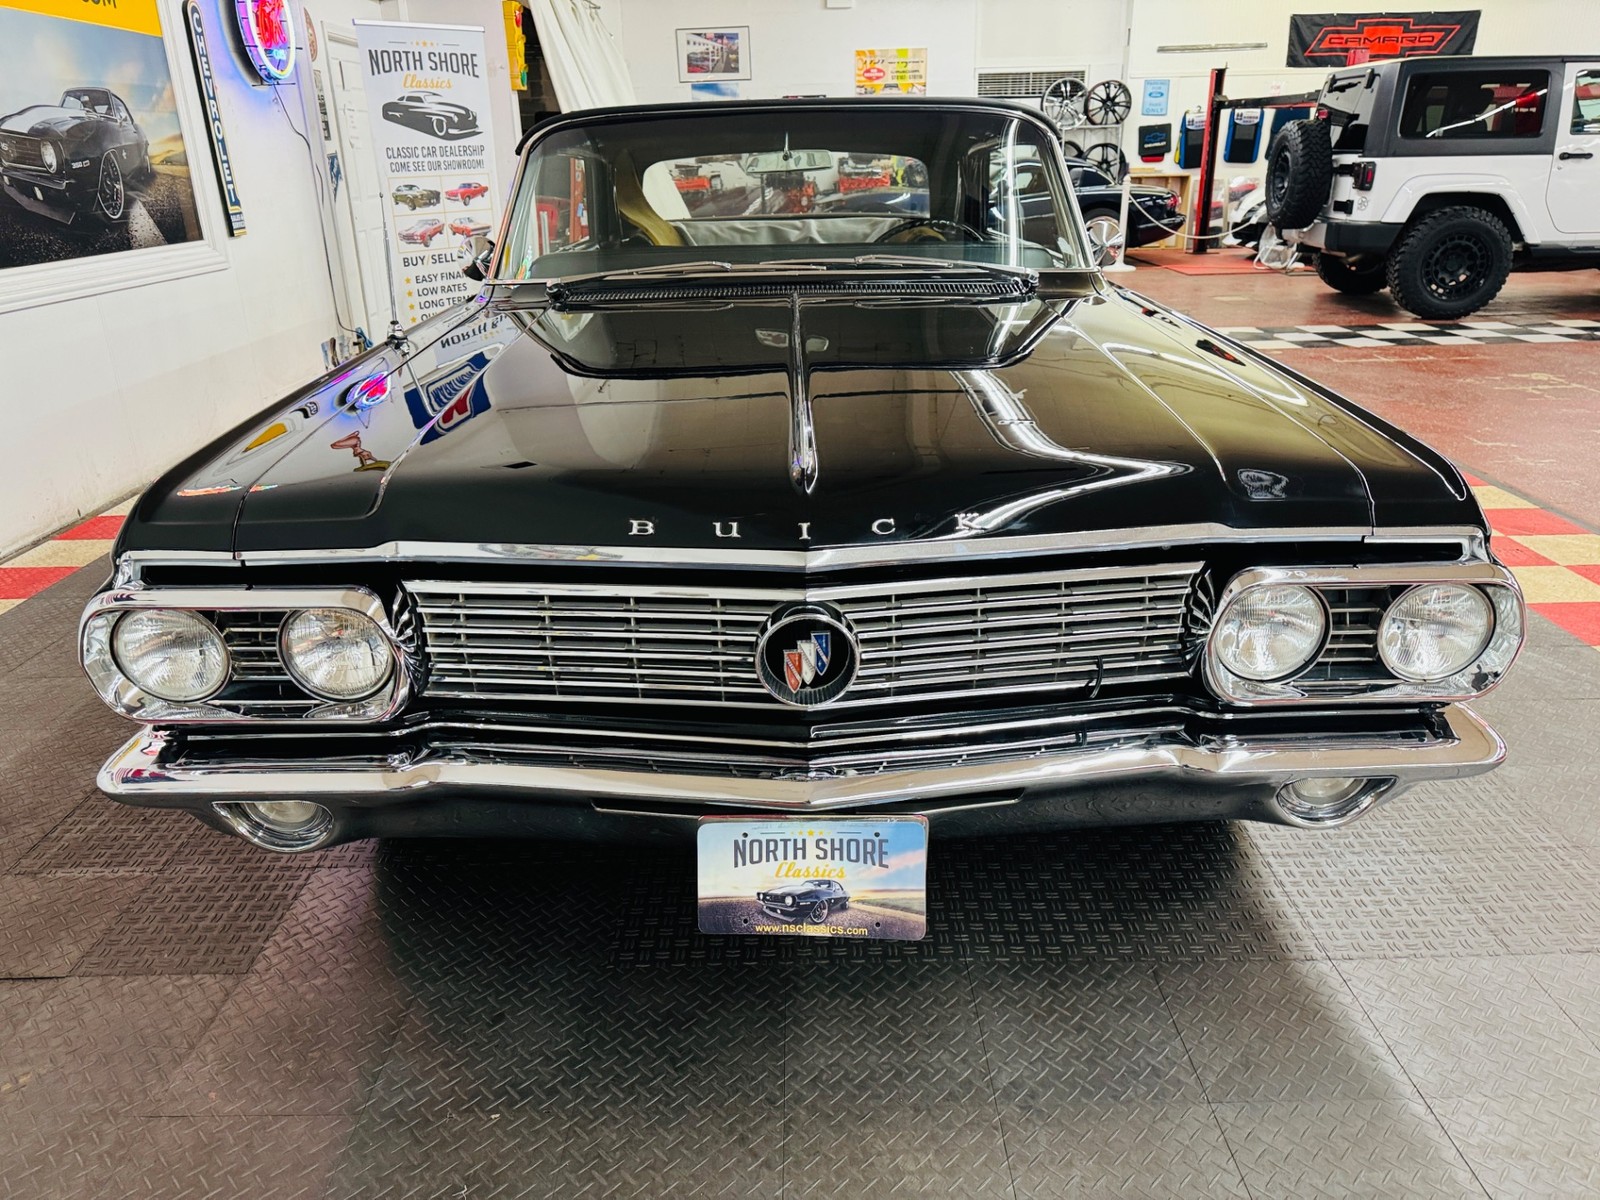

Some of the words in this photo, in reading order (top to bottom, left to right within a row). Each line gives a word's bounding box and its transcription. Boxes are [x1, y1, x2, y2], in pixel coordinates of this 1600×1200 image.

[1328, 35, 1435, 45] CAMARO
[368, 49, 423, 76] NORTH
[428, 51, 479, 78] SHORE
[402, 73, 452, 90] Classics
[192, 12, 235, 203] CHEVROLET
[386, 147, 419, 159] CLASSIC
[421, 146, 437, 158] CAR
[439, 145, 485, 157] DEALERSHIP
[390, 161, 411, 173] COME
[412, 161, 426, 172] SEE
[427, 160, 442, 171] OUR
[443, 159, 485, 170] SHOWROOM!
[415, 274, 439, 284] EASY
[417, 287, 439, 297] LOW
[440, 283, 468, 294] RATES
[418, 299, 445, 310] LONG
[628, 513, 984, 540] BUICK
[733, 838, 807, 869] NORTH
[815, 838, 890, 869] SHORE
[774, 861, 847, 880] Classics
[755, 924, 868, 937] www.nsclassics.com
